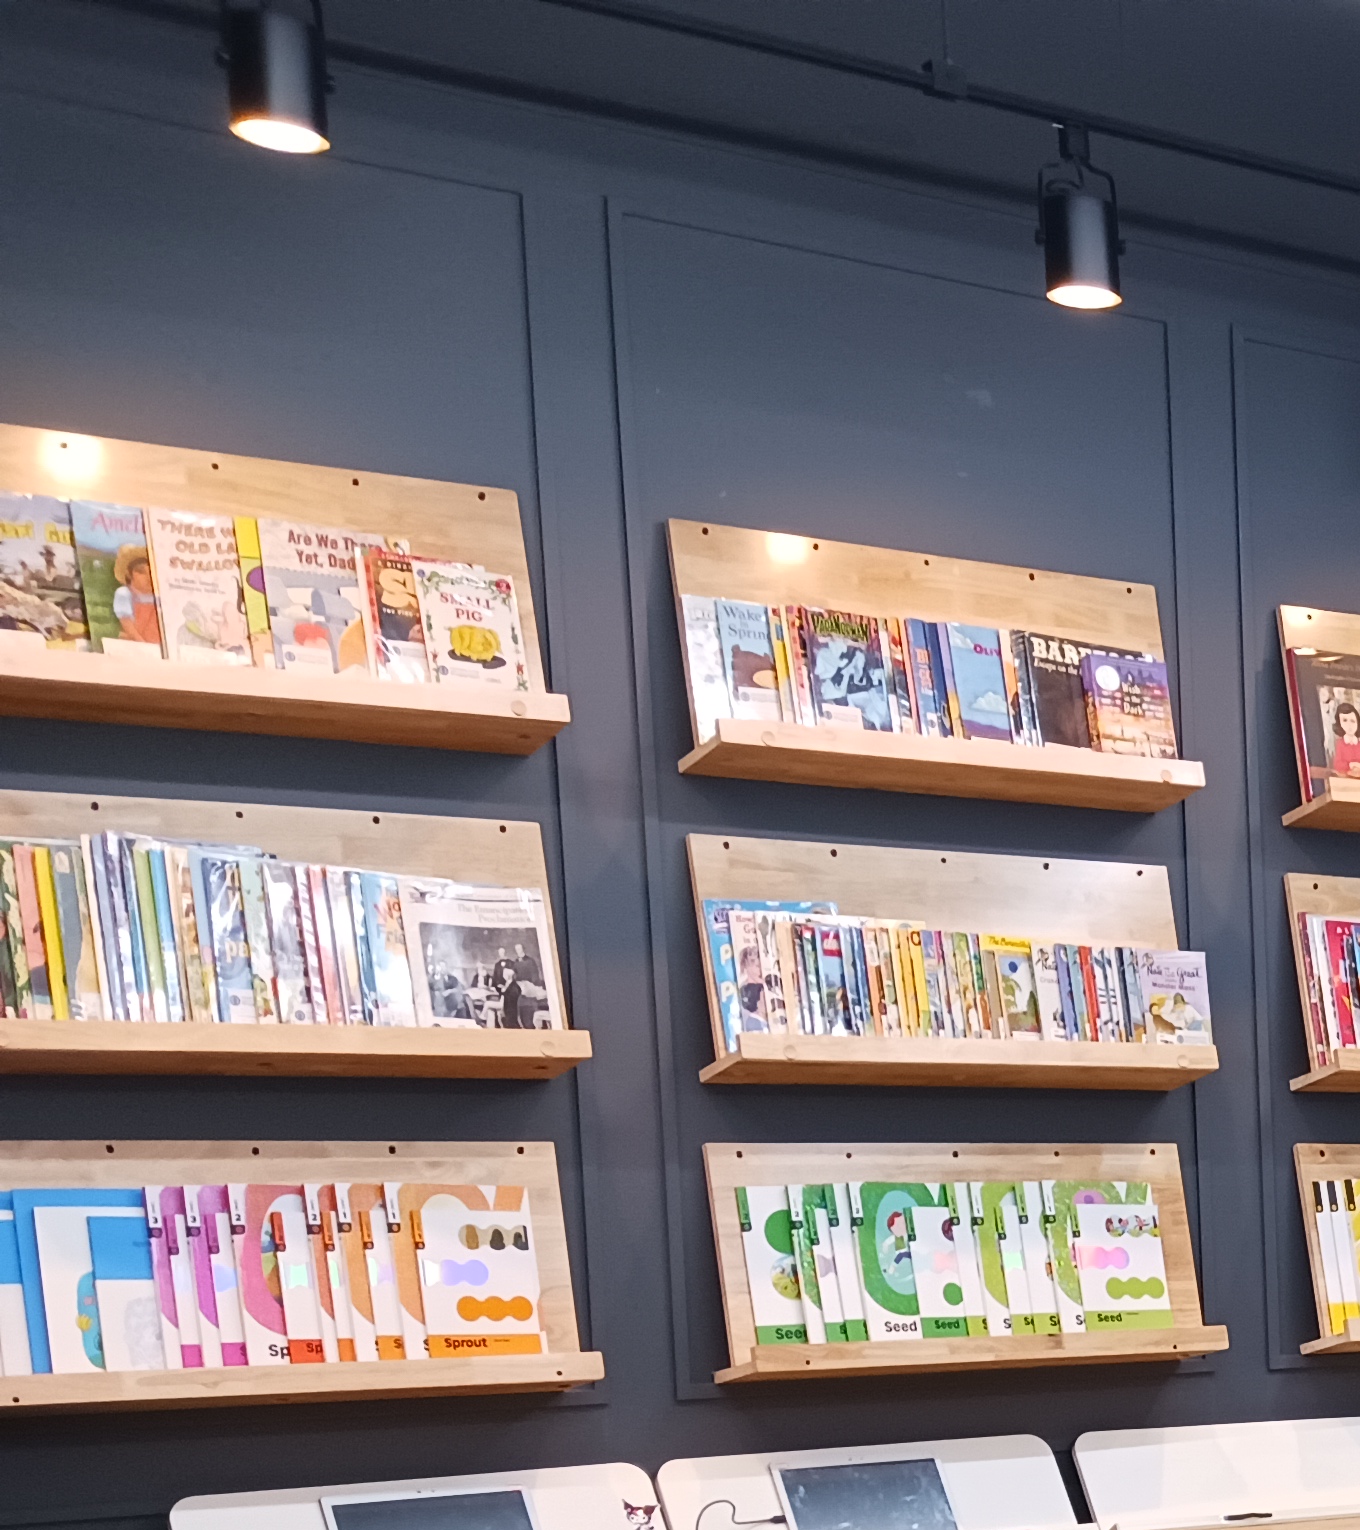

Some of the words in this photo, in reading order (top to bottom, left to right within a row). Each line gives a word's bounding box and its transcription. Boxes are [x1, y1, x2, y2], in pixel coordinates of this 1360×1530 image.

[288, 529, 312, 546] Are
[315, 533, 338, 551] We
[175, 540, 211, 555] OLD
[296, 549, 323, 568] Yet,
[455, 608, 483, 622] PIG
[721, 605, 762, 623] Wake
[1097, 1312, 1123, 1323] Seed
[884, 1321, 918, 1333] Seed
[934, 1320, 960, 1331] Seed
[444, 1338, 488, 1352] Sprout
